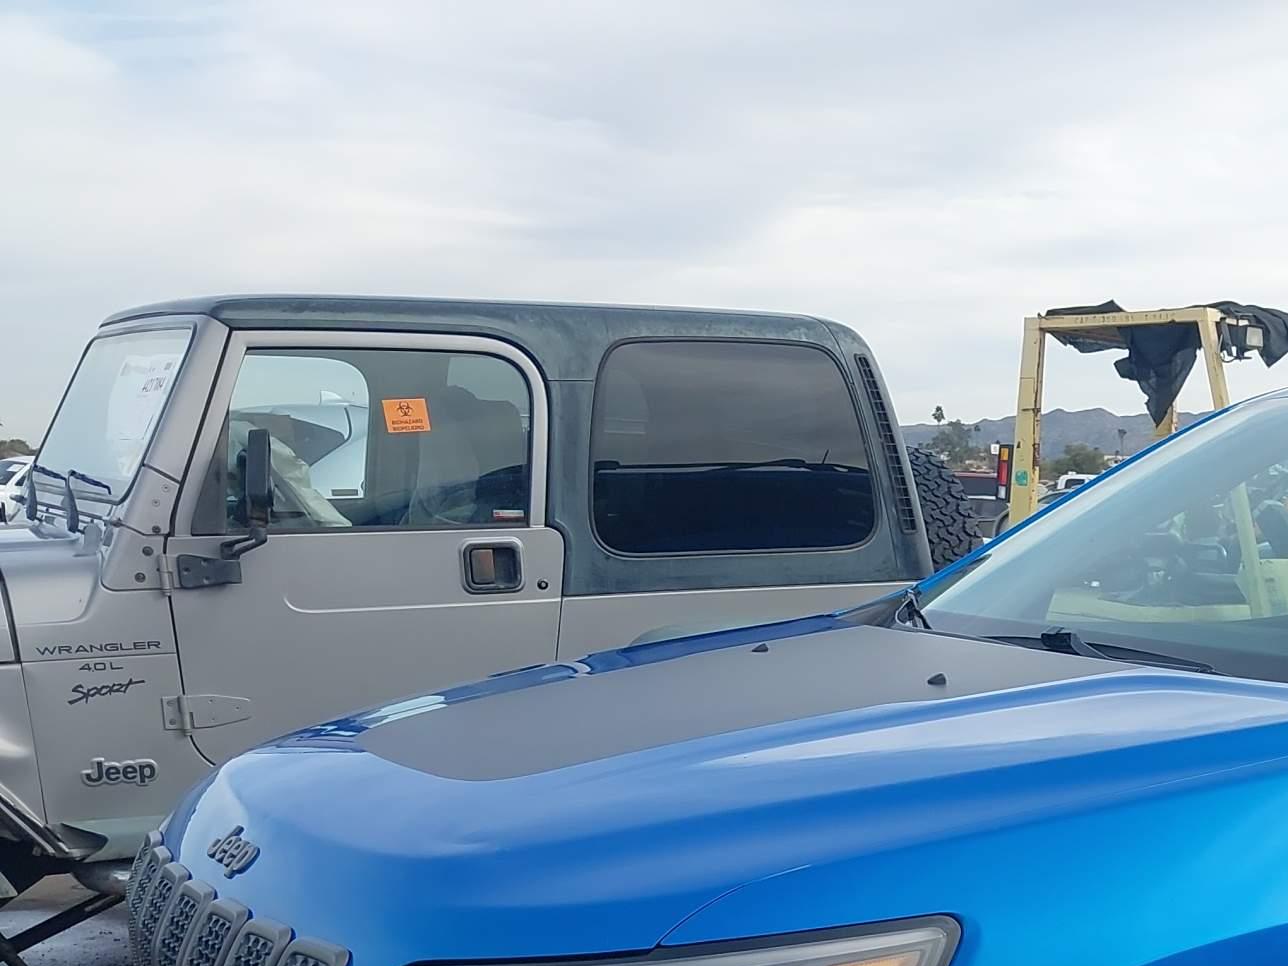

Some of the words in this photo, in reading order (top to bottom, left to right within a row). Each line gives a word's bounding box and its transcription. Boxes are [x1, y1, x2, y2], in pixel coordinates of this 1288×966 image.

[36, 640, 161, 655] WRANGLER
[68, 677, 145, 705] Sport
[83, 759, 158, 785] Jeep
[207, 825, 260, 879] Jeep
